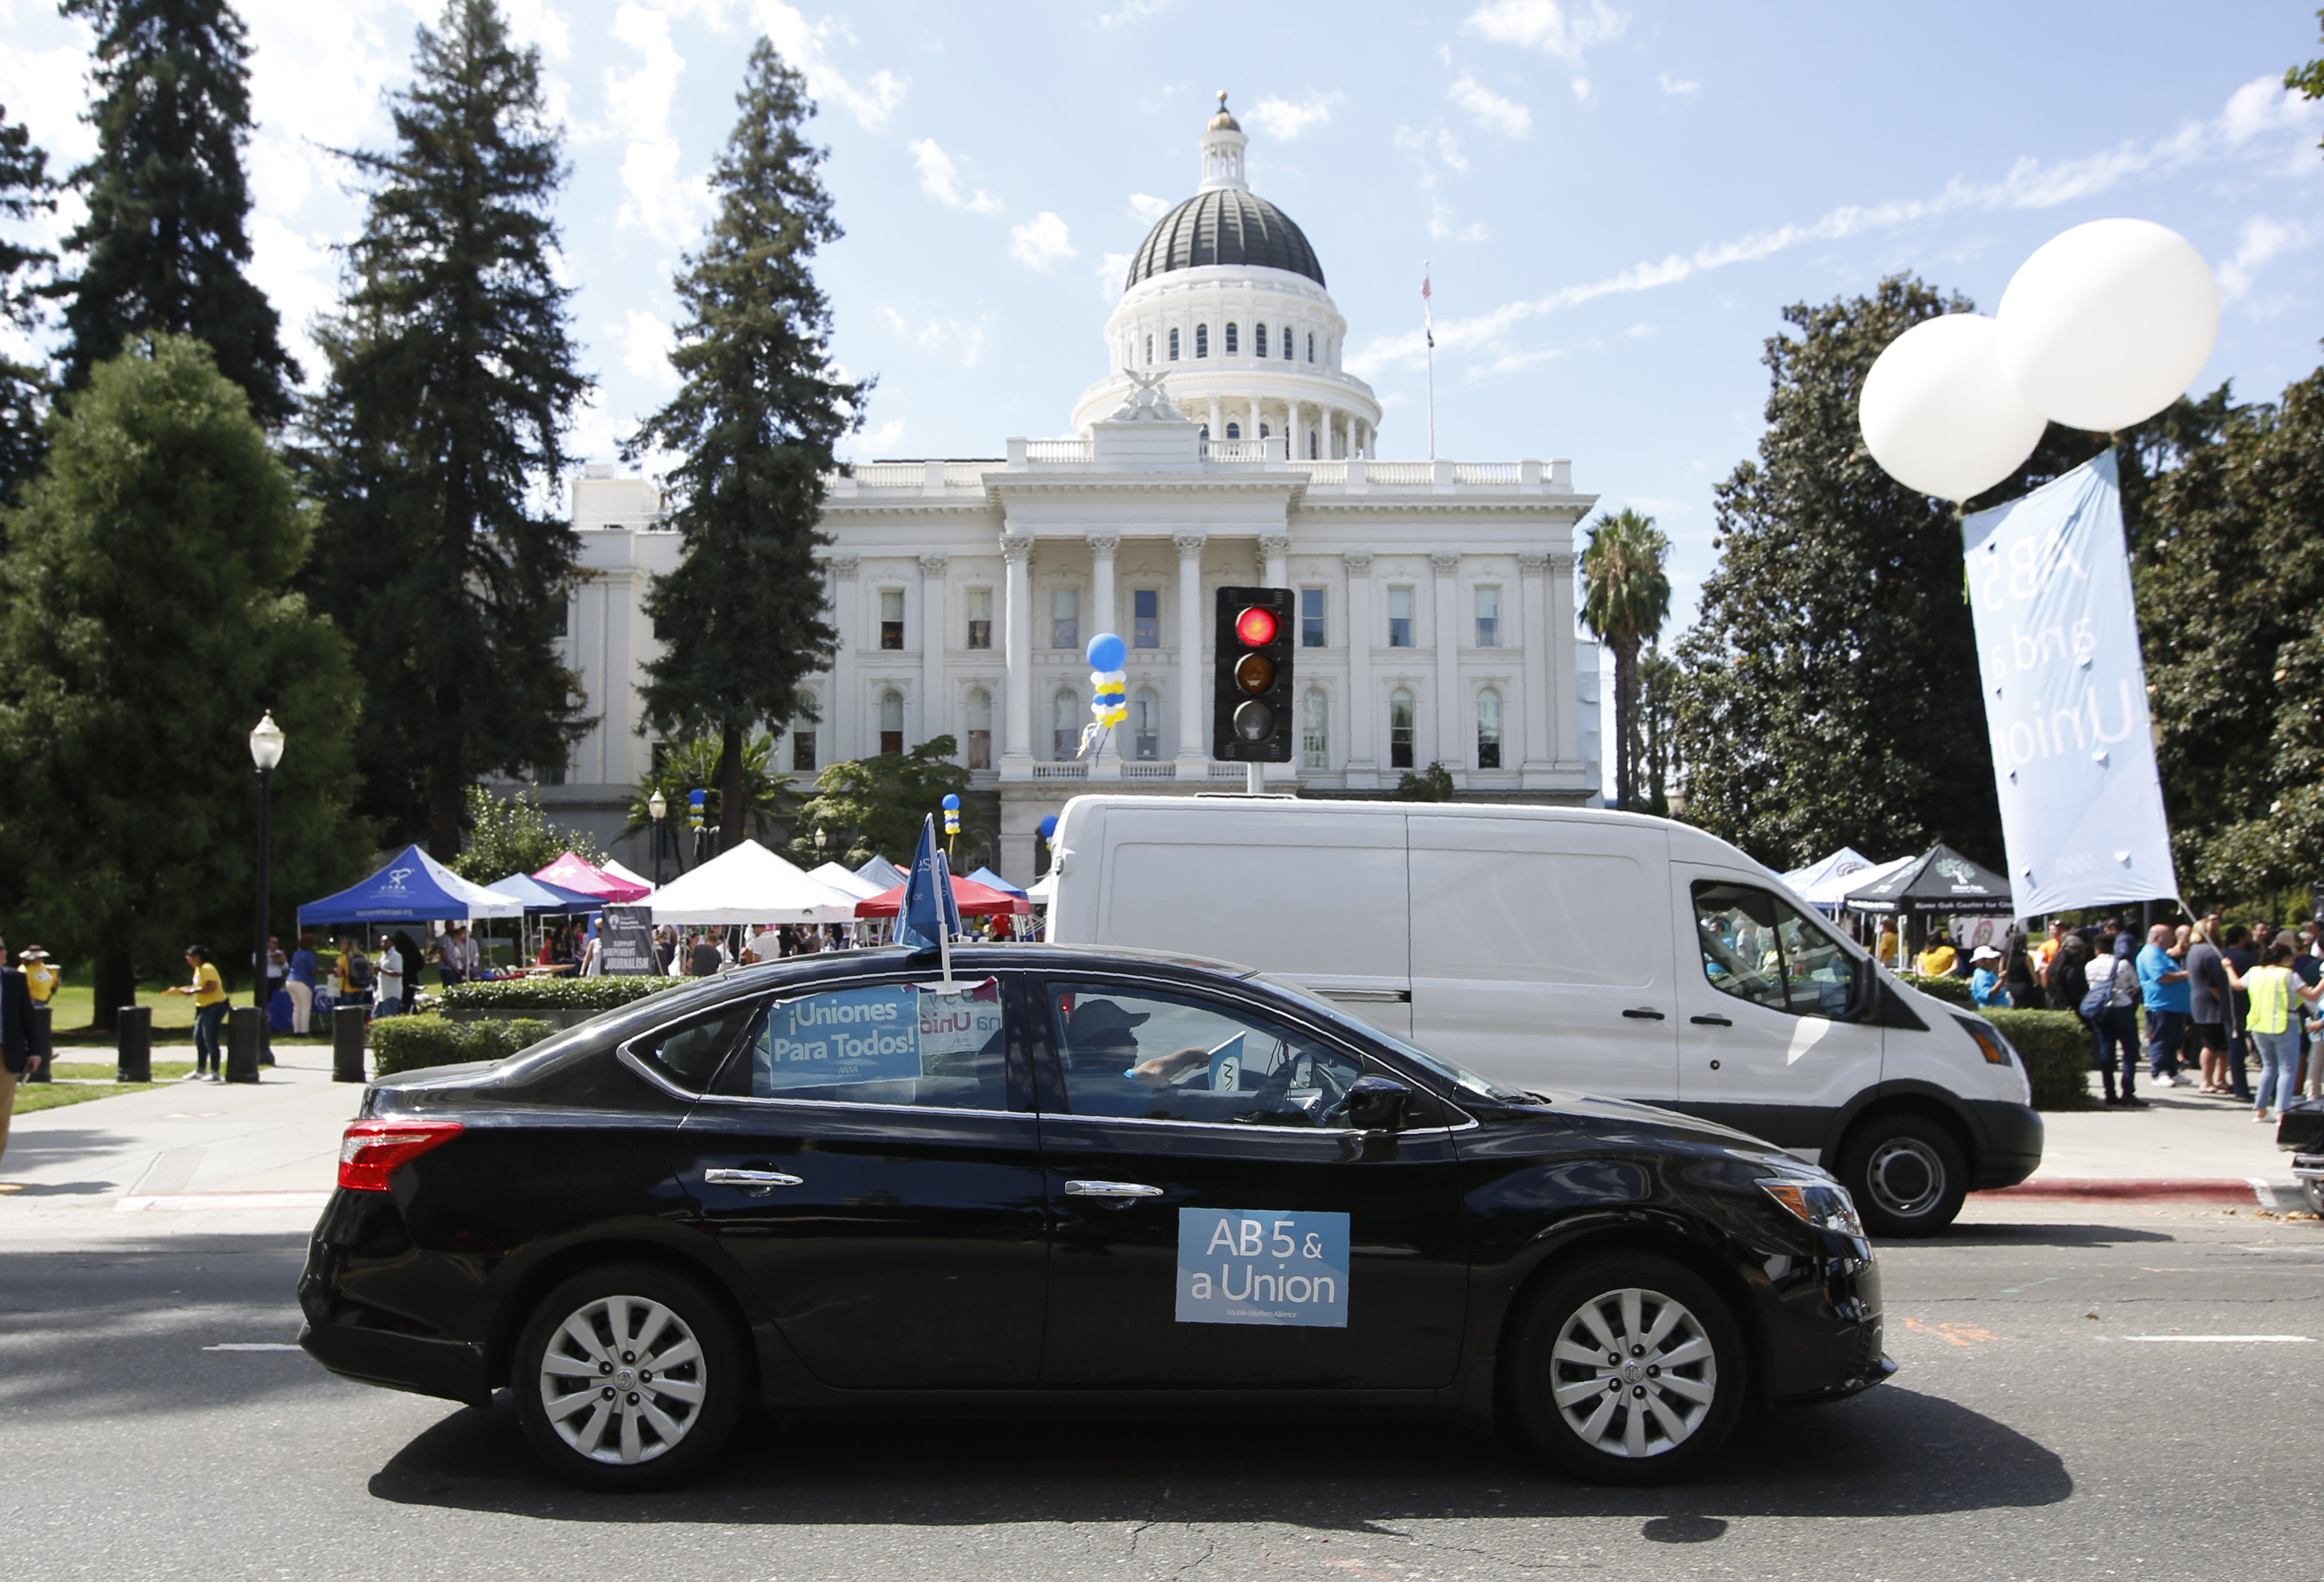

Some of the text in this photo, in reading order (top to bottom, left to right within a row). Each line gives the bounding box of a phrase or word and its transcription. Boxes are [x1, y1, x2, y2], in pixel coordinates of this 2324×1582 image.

[605, 957, 649, 970] JOURNALISM
[790, 999, 898, 1035] ¡Uniones
[774, 1026, 915, 1062] Para Todos!
[1303, 1232, 1323, 1259] &
[1191, 1263, 1335, 1303] a Union
